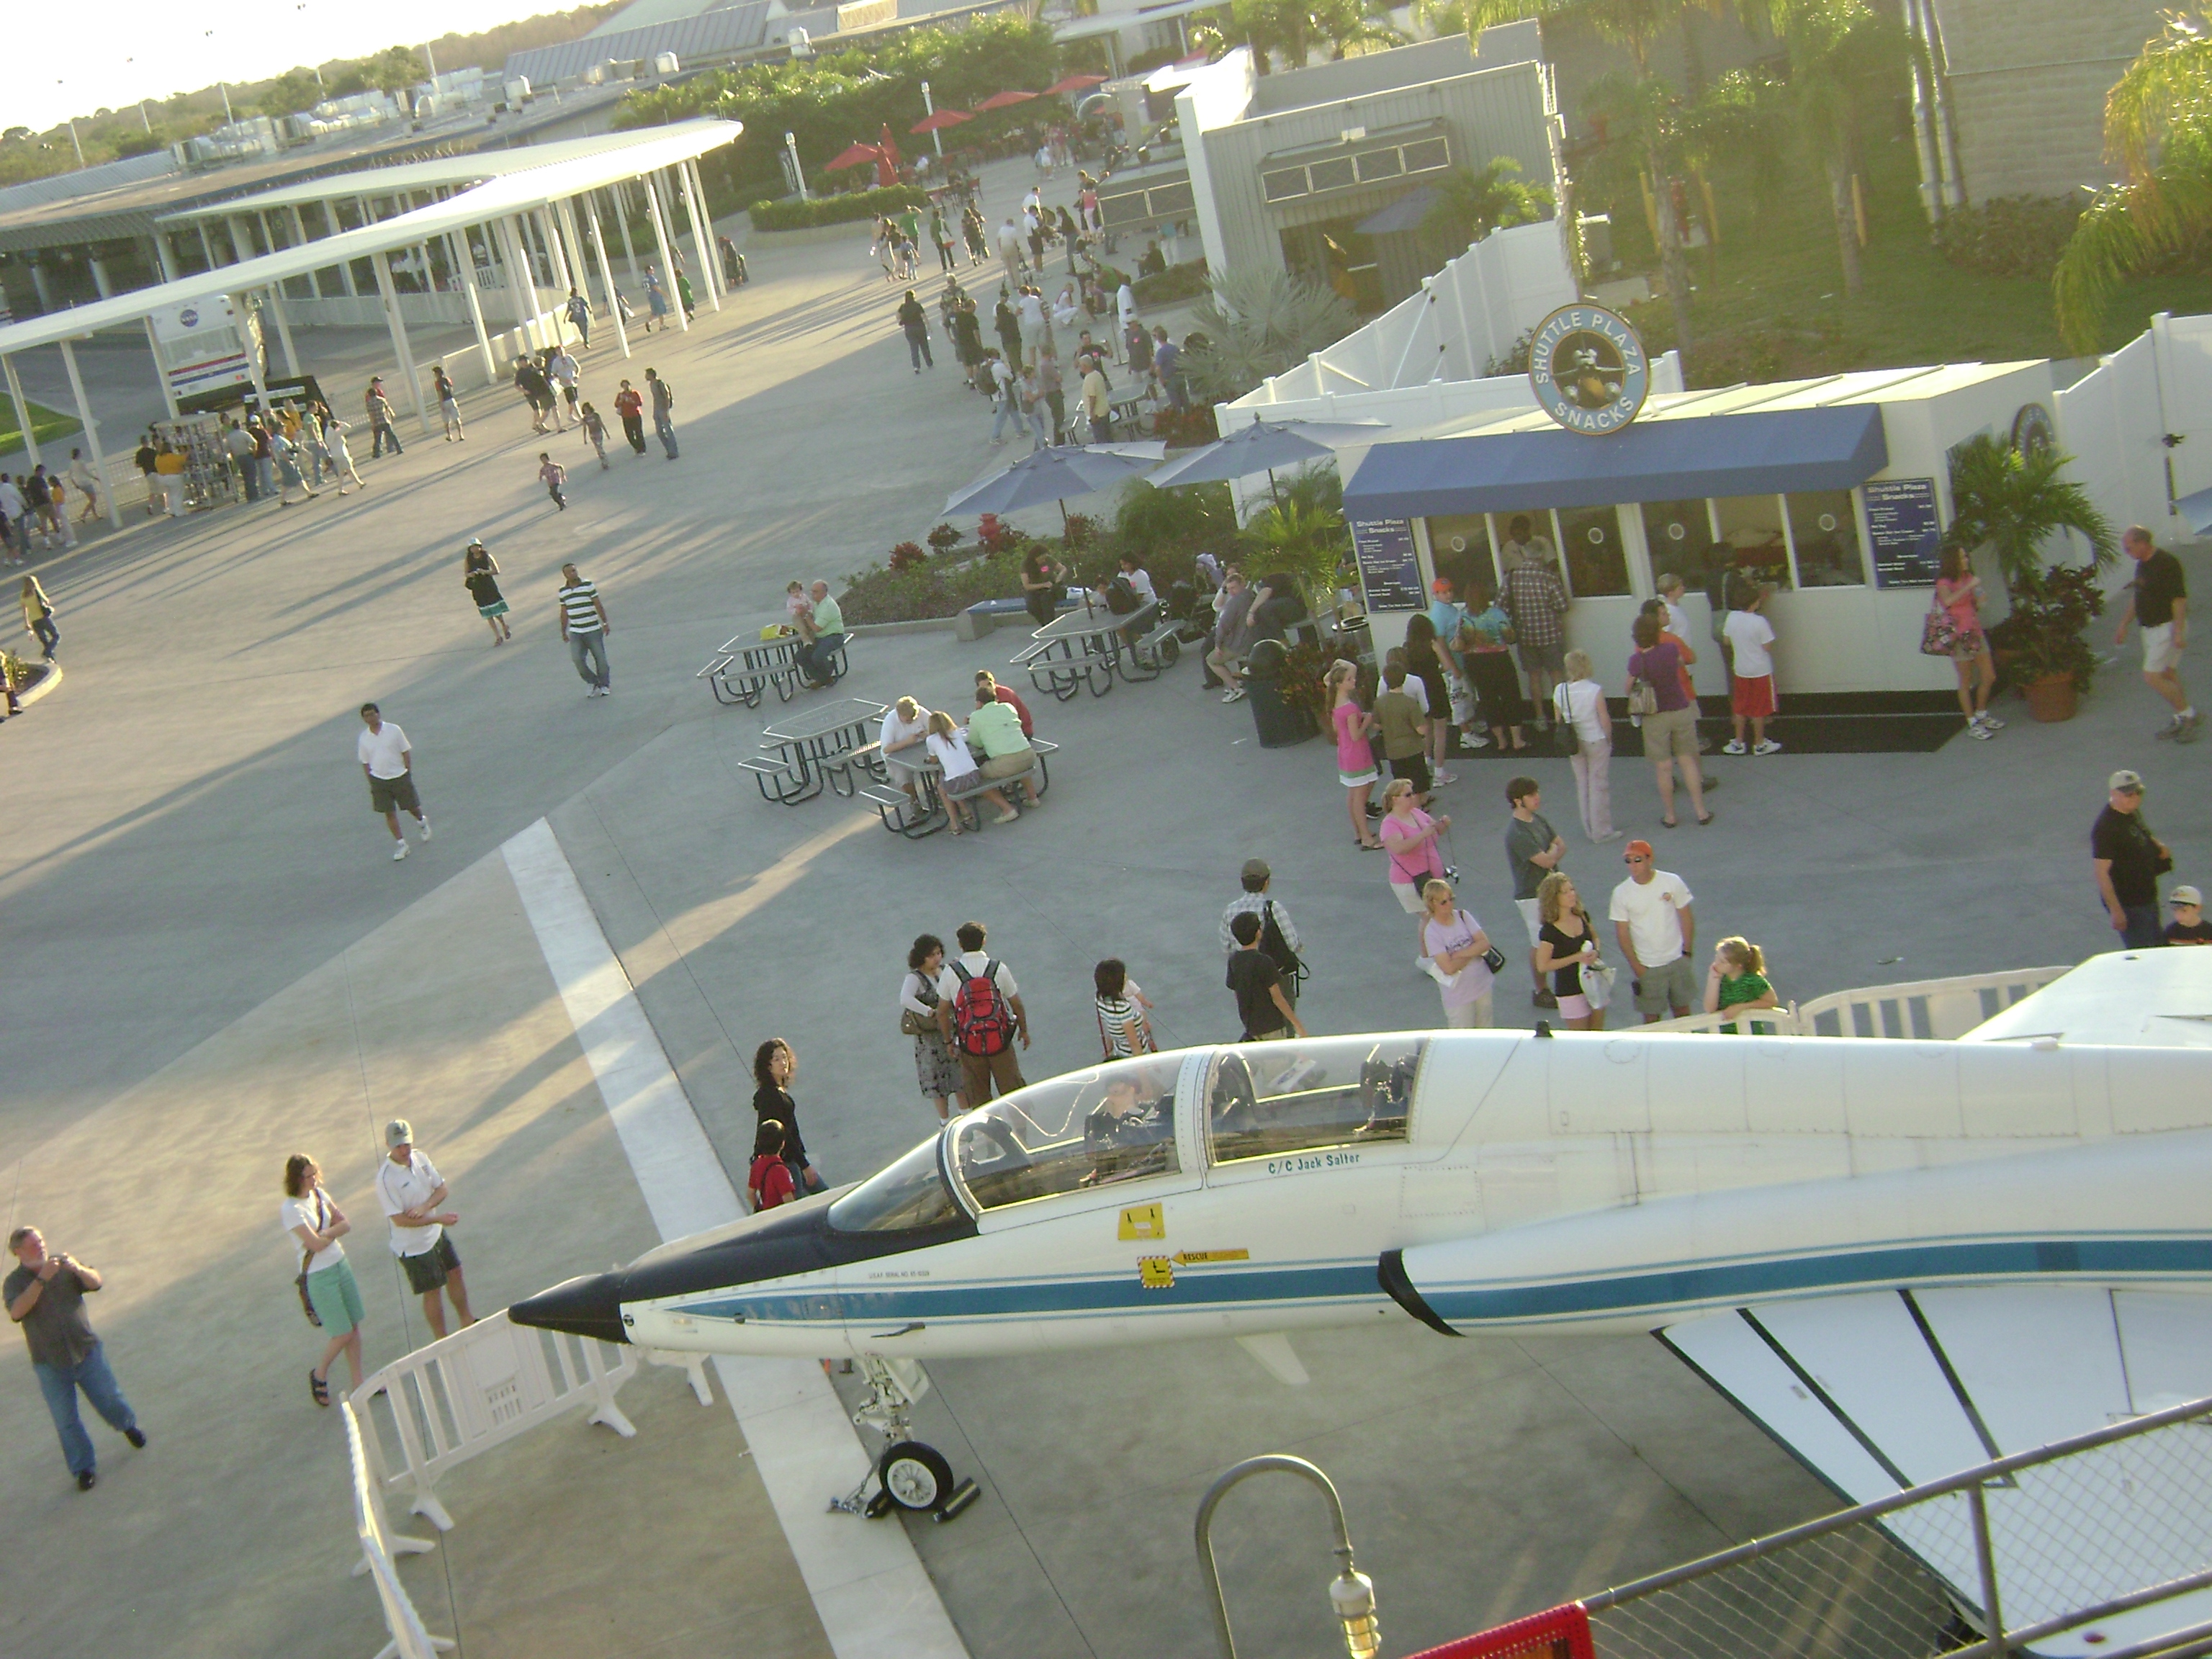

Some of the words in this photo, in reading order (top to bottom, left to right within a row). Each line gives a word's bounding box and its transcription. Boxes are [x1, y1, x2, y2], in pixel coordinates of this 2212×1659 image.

[1533, 312, 1583, 385] SHUTTLE
[1591, 314, 1641, 375] PLAZA
[1554, 396, 1635, 429] SNACKS
[1268, 1160, 1292, 1174] C/C
[1298, 1156, 1321, 1171] Jack
[1326, 1153, 1359, 1166] Salter
[1182, 1251, 1208, 1261] RESCUE
